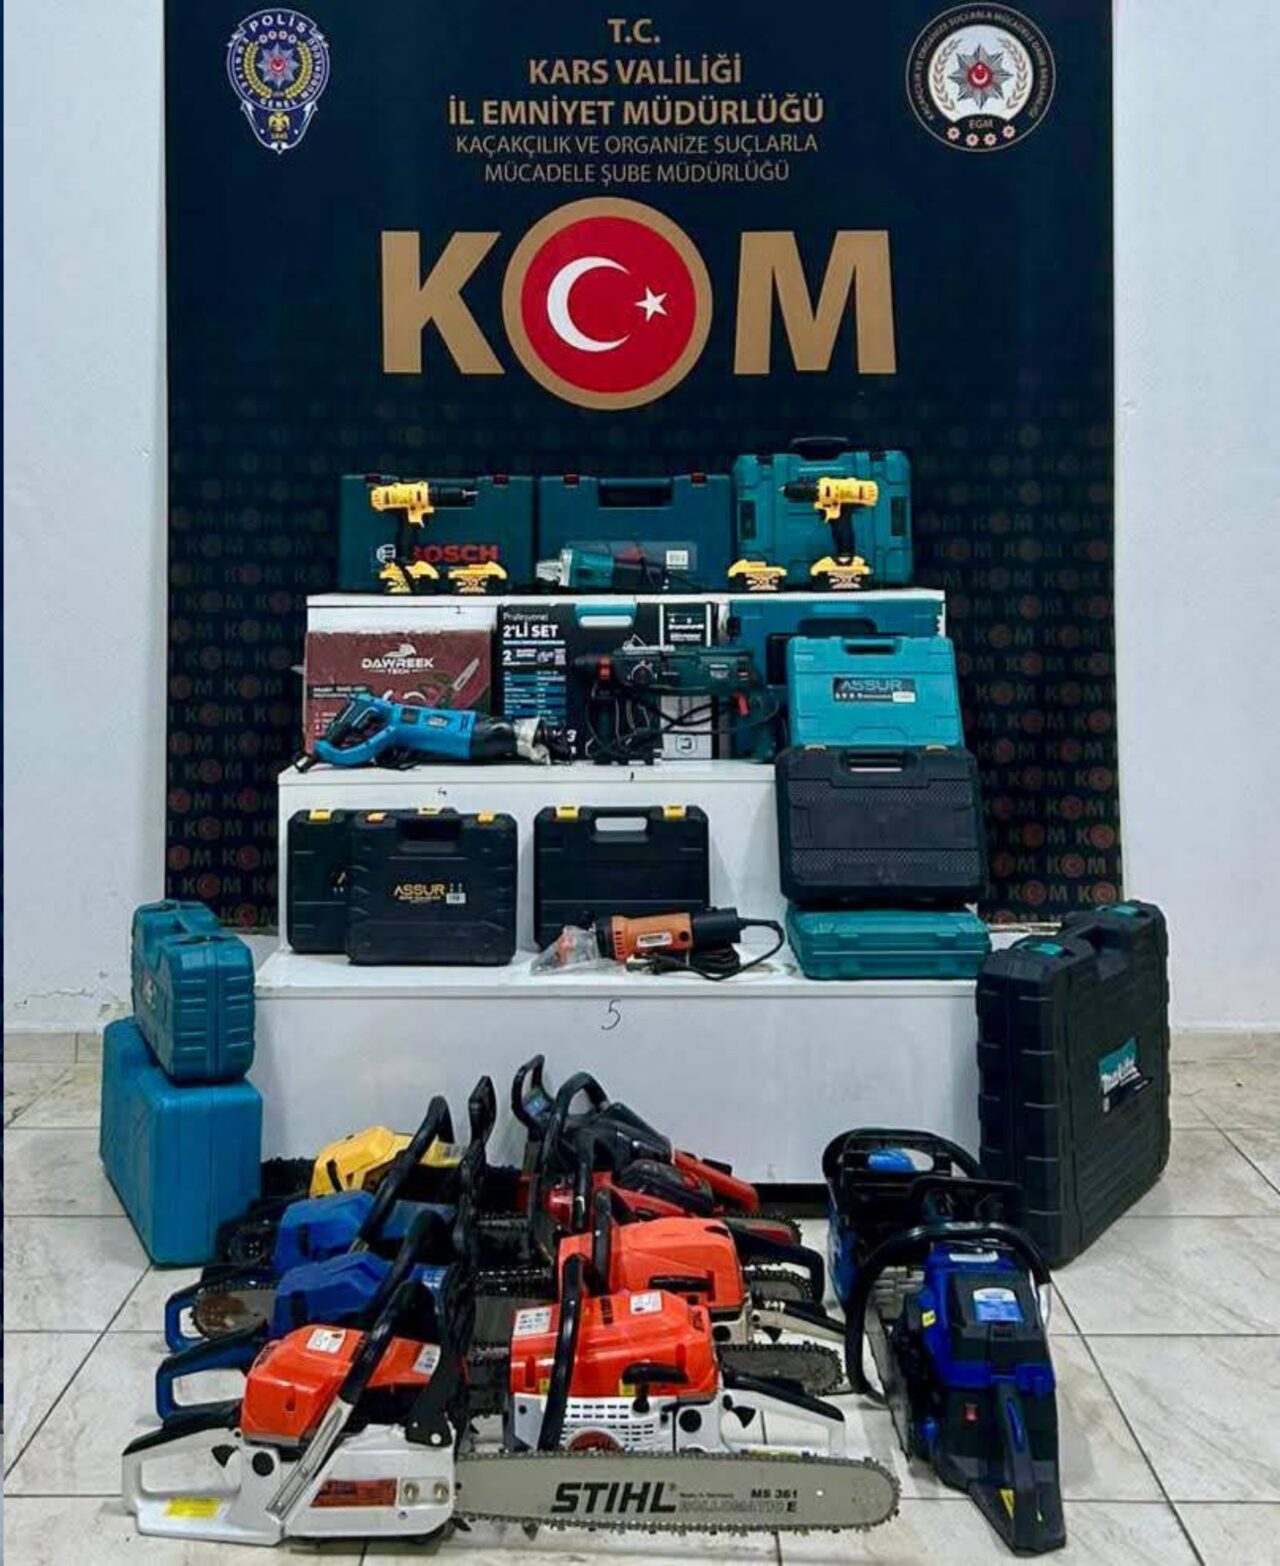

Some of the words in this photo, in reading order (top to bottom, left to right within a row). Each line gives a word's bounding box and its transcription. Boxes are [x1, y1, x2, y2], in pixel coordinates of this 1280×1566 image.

[249, 13, 308, 33] POLİS
[607, 18, 661, 44] T.C.
[529, 59, 609, 85] KARS
[615, 53, 742, 85] VALİLİĞİ
[448, 94, 475, 125] İL
[482, 94, 615, 126] EMNİYET
[623, 92, 825, 126] MÜDÜRLÜĞÜ
[969, 119, 994, 129] EGM
[456, 135, 572, 158] KAÇAKÇILIK
[575, 135, 600, 154] VE
[604, 133, 708, 155] ORGANİZE
[714, 133, 819, 157] SUÇLARLA
[484, 161, 595, 183] MÜCADELE
[601, 164, 651, 187] ŞUBE
[657, 159, 790, 183] MÜDÜRLÜĞÜ
[531, 624, 559, 638] SET
[361, 657, 434, 669] DAWREEK
[502, 650, 512, 662] 2
[841, 679, 902, 691] ASSUR
[393, 883, 446, 897] ASSUR
[600, 1000, 622, 1032] 5
[551, 1481, 677, 1514] STIHL
[750, 1488, 771, 1499] MS
[774, 1488, 798, 1499] 361
[786, 1500, 798, 1513] E
